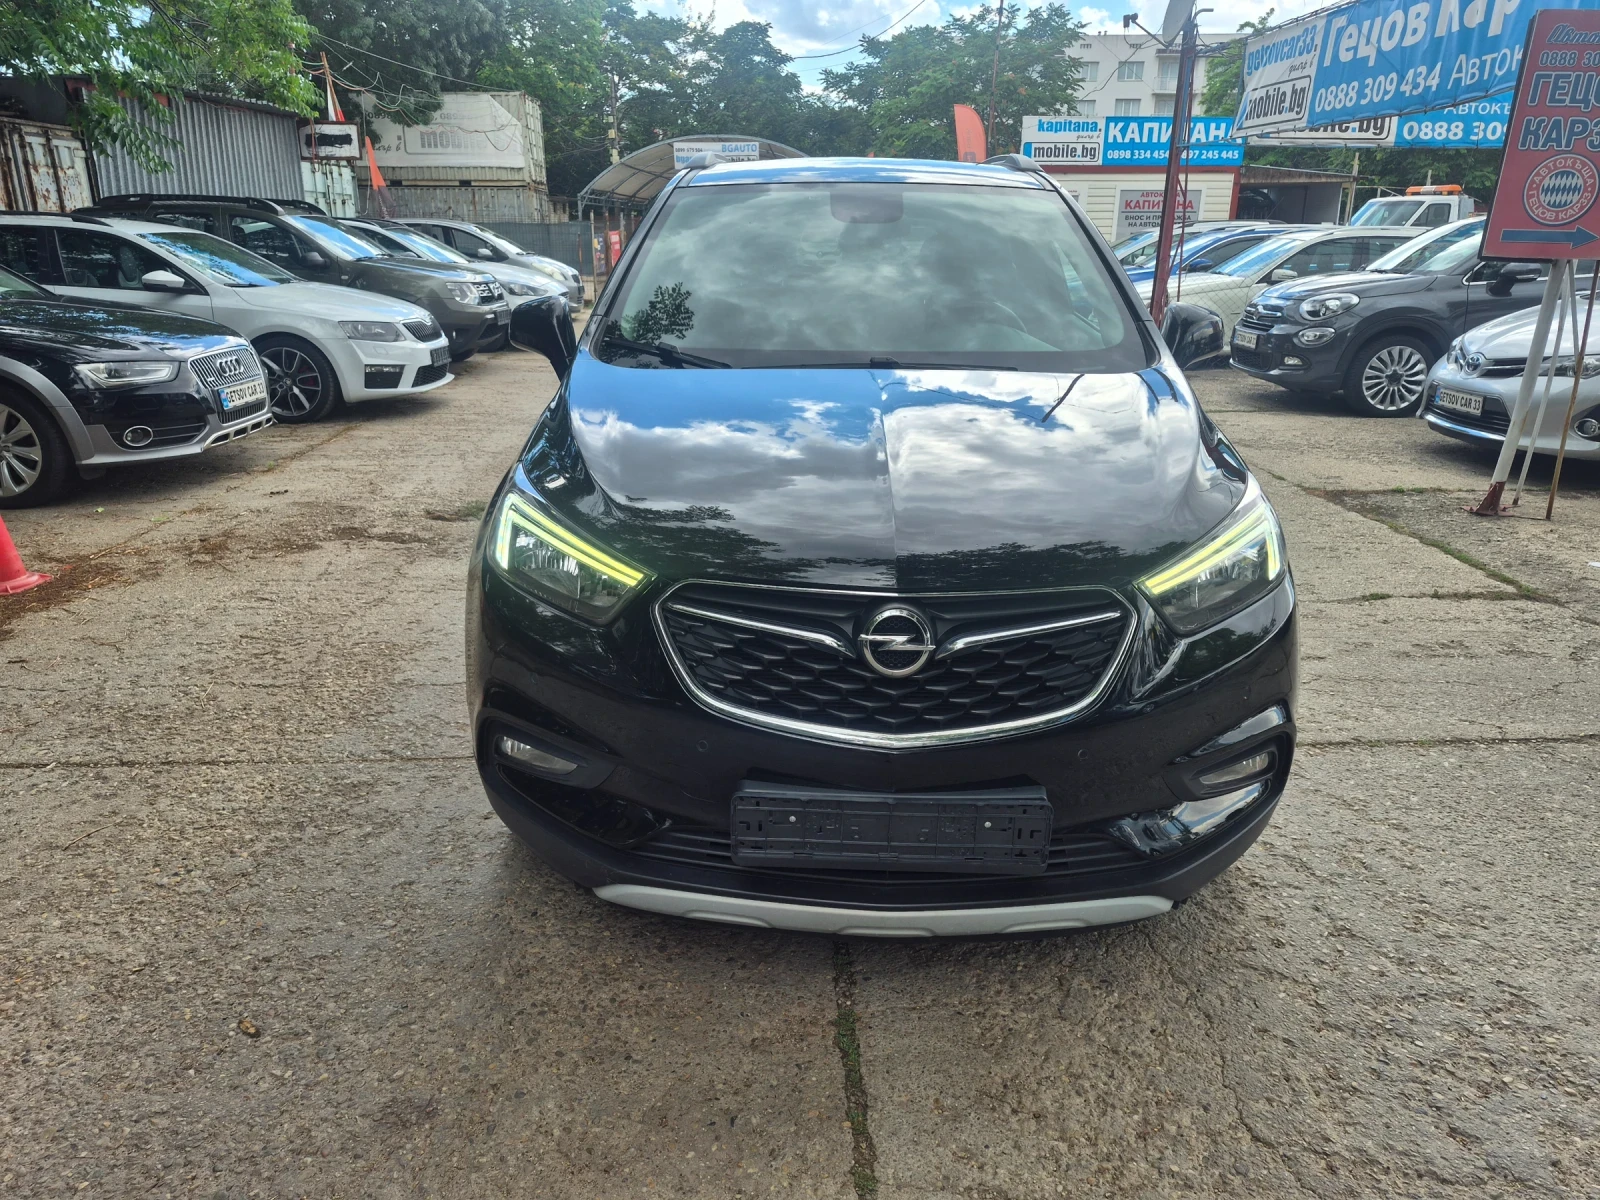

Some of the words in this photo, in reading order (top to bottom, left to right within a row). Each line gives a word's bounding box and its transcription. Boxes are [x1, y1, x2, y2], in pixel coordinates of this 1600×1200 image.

[1323, 2, 1430, 67] Гецов
[1539, 51, 1578, 66] 0888
[1315, 81, 1358, 112] 0888
[1360, 72, 1397, 105] 309
[1400, 62, 1442, 96] 434
[1245, 83, 1307, 121] mobile.bg
[1107, 121, 1243, 144] КАПИАНА
[1403, 121, 1465, 141] 0888
[721, 143, 757, 153] BGAUTO
[1033, 144, 1097, 160] mobile.bg
[1107, 150, 1131, 159] 0898
[1133, 150, 1150, 159] 334
[1201, 150, 1219, 159] 245
[1222, 150, 1239, 159] 445
[1534, 158, 1594, 185] АВТОКЪЩА
[1125, 199, 1194, 210] КАПИНА
[1529, 190, 1555, 220] ГЕЦОВ
[226, 388, 247, 403] GETSOV
[247, 384, 257, 398] CAR
[1440, 391, 1459, 405] GETSOV
[1460, 396, 1472, 409] CAR
[1473, 399, 1480, 411] 33
